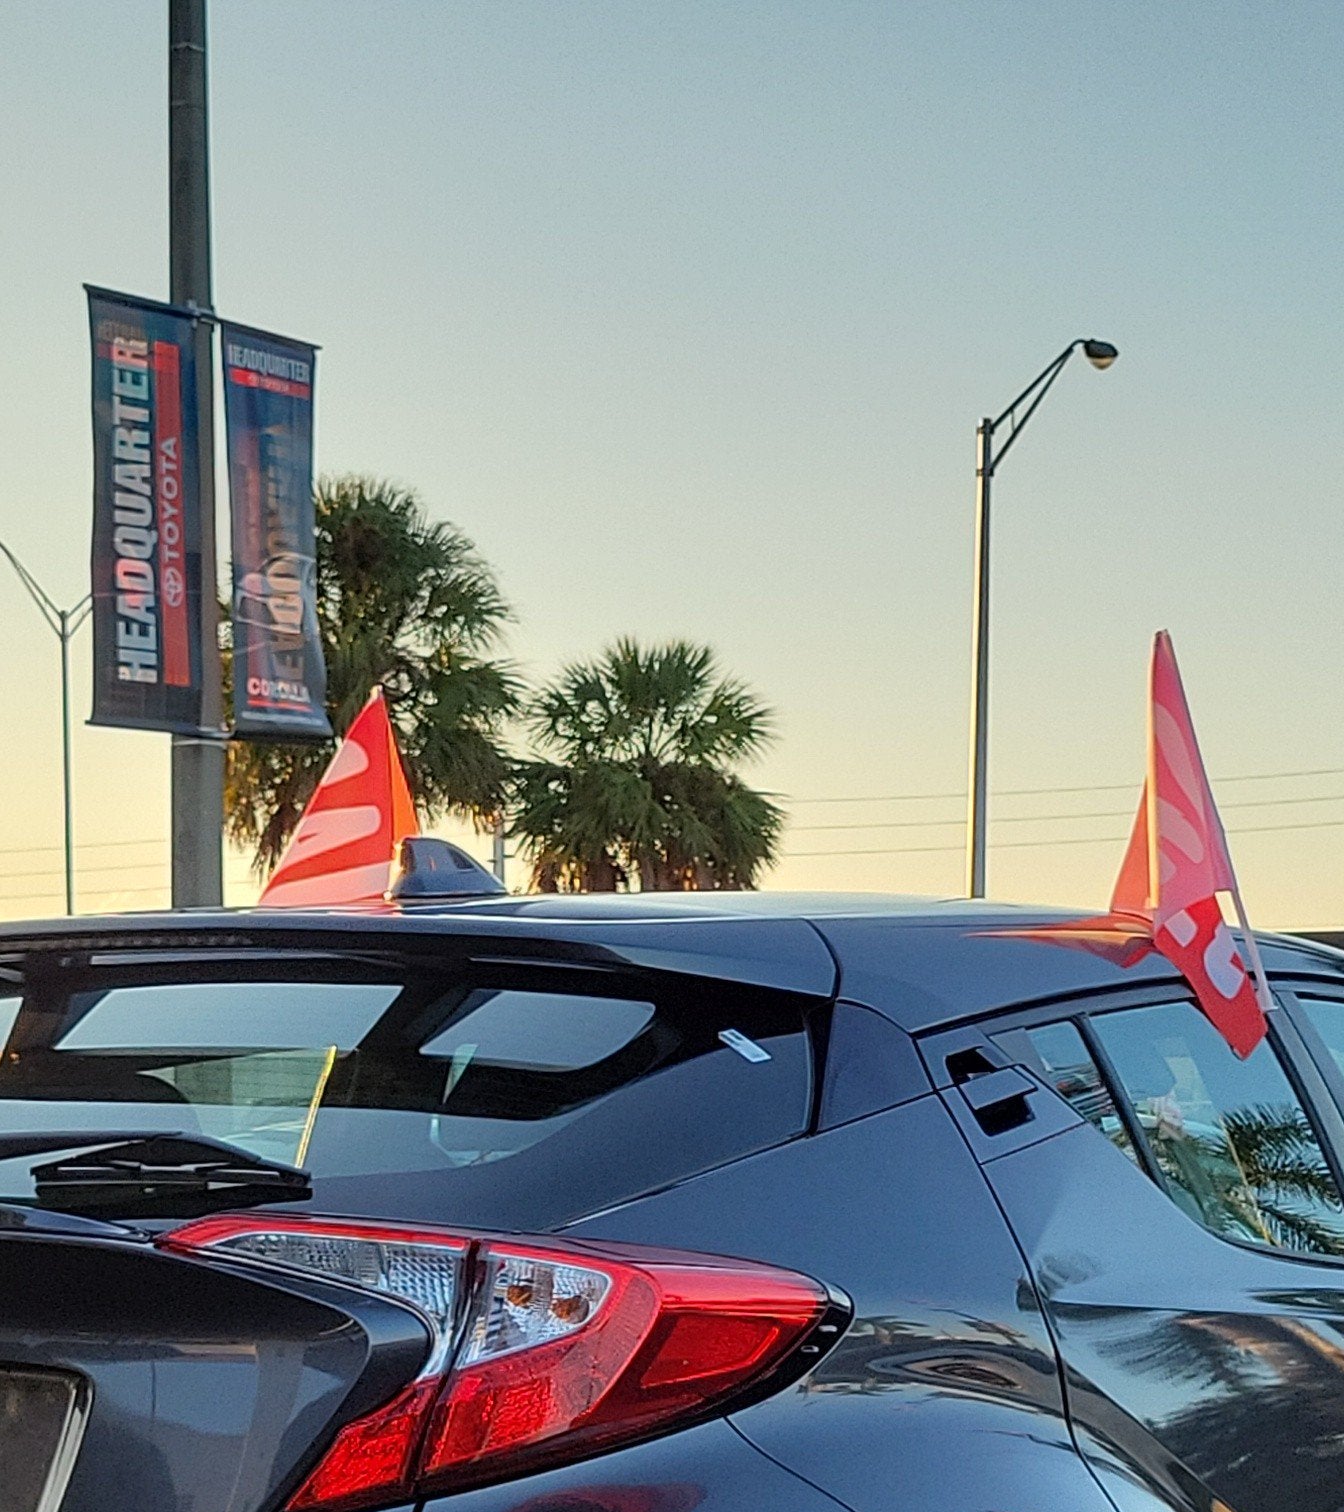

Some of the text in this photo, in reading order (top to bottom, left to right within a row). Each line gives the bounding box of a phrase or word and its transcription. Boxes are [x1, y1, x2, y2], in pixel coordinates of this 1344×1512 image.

[228, 343, 311, 385] HEADQUARTER
[113, 337, 158, 684] HEADQUARTER
[160, 437, 180, 563] TOYOTA
